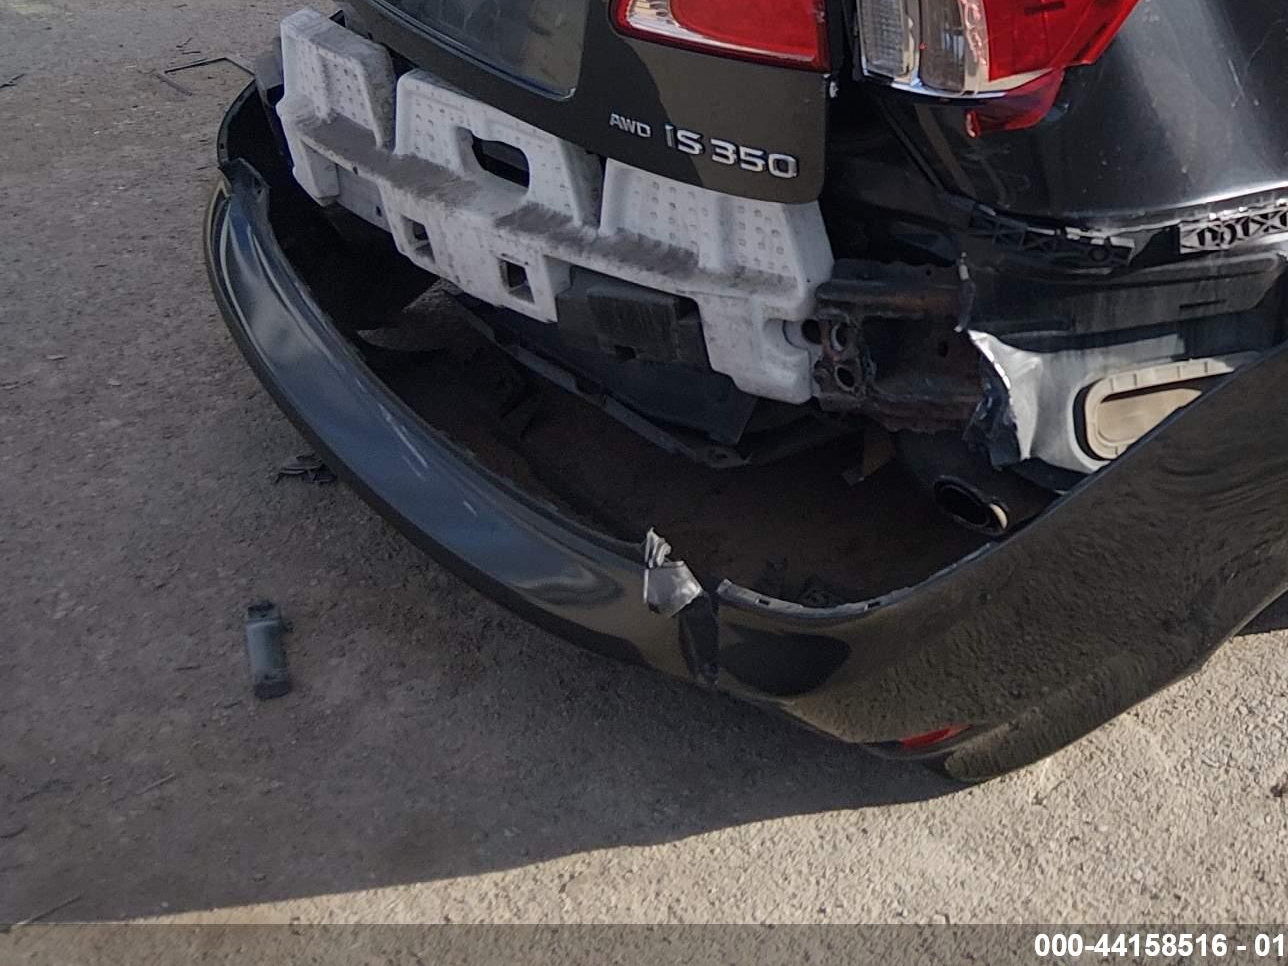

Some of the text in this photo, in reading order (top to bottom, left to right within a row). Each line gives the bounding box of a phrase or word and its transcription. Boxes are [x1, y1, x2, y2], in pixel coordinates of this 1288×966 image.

[609, 113, 799, 179] AWD IS 350
